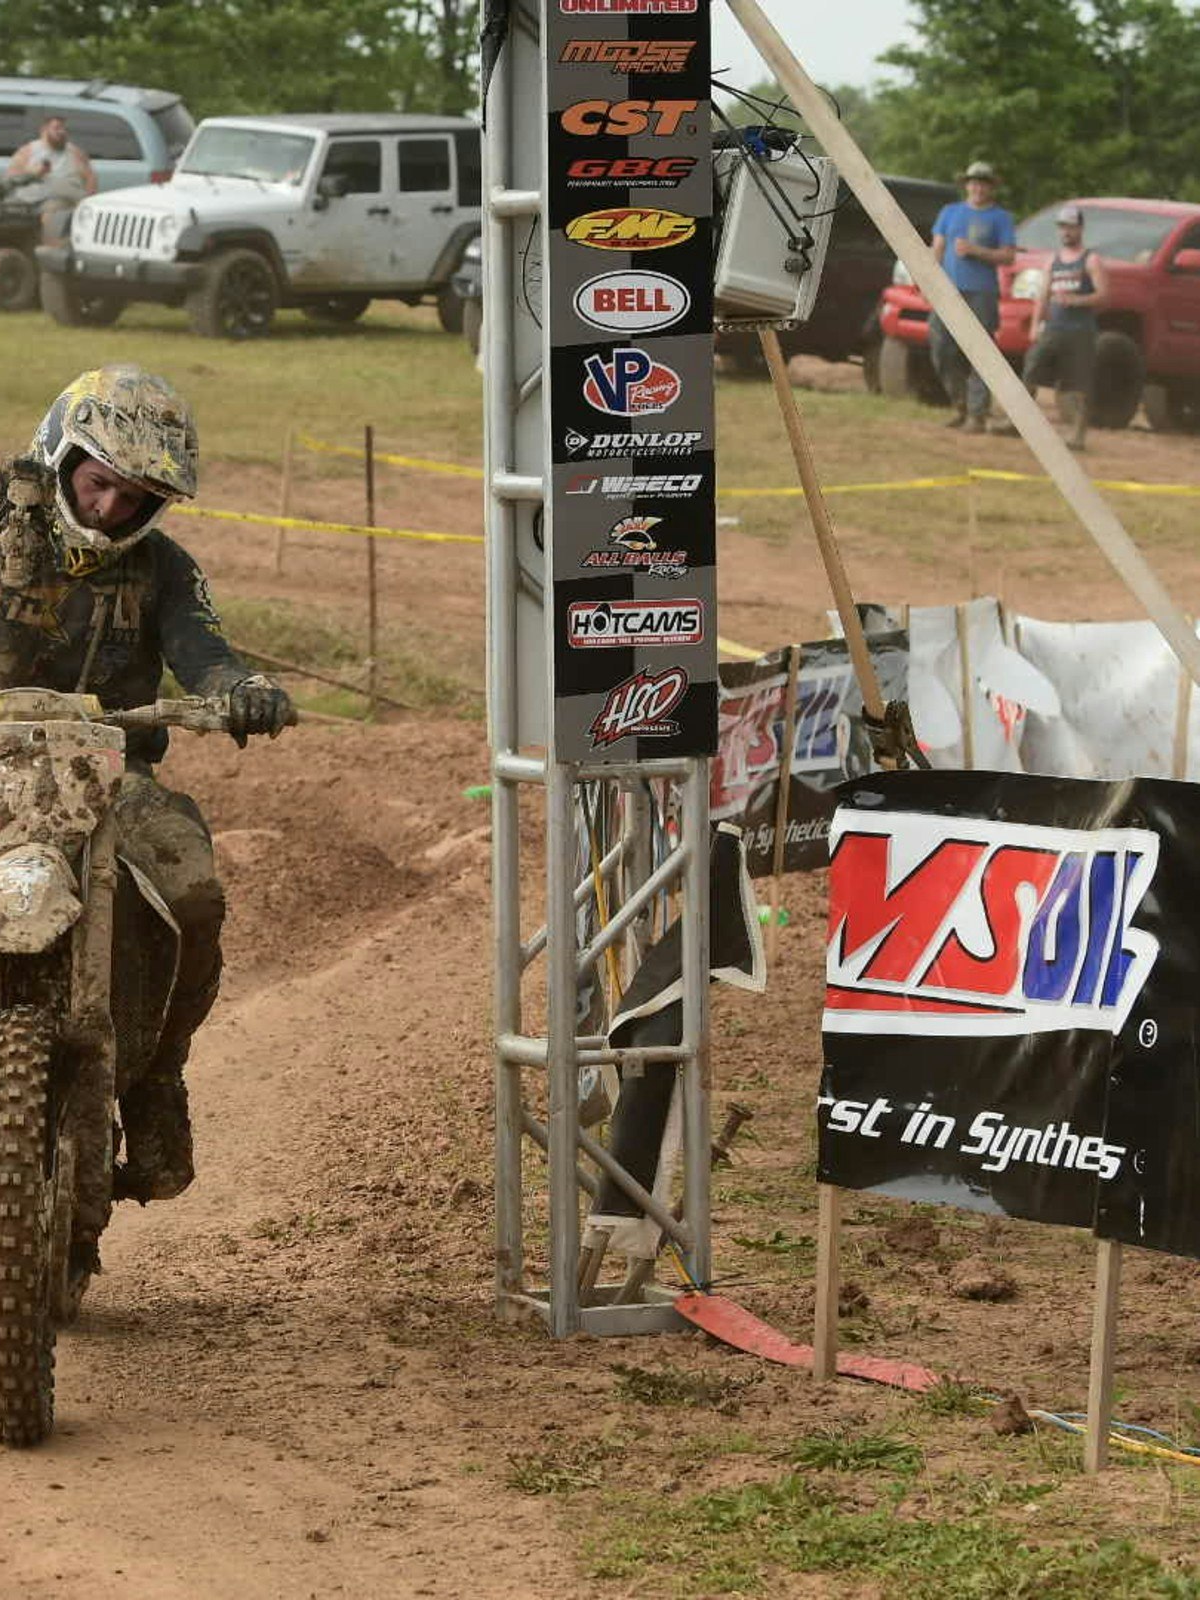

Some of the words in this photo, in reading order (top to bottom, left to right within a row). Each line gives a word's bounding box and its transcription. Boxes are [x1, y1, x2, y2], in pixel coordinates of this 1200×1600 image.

[560, 40, 697, 62] MOOSE
[613, 61, 688, 73] RACING
[561, 100, 698, 136] CST
[567, 158, 697, 178] GBC
[567, 213, 696, 240] FMF
[594, 288, 672, 312] BELL
[584, 348, 650, 413] VP
[587, 447, 655, 457] MOTORCYCLE
[661, 446, 693, 456] TIRES
[590, 432, 702, 448] DUNLOP
[580, 551, 621, 568] ALL
[622, 550, 688, 566] BALLS
[573, 602, 698, 635] HOTCAMS
[900, 1103, 956, 1149] in
